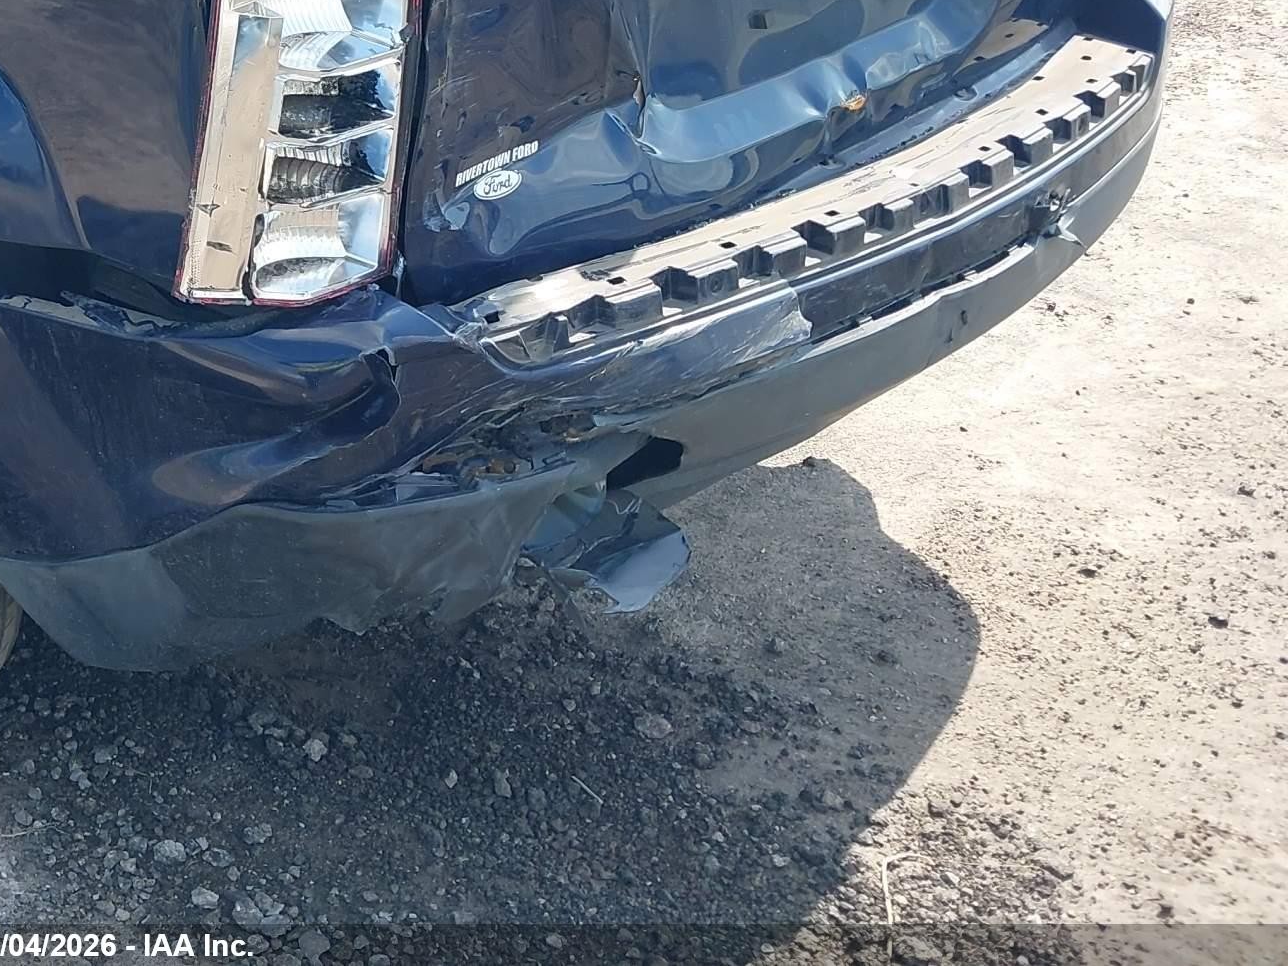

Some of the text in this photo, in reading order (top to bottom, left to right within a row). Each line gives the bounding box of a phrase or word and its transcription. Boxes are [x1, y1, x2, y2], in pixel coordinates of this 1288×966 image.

[455, 140, 539, 188] RIVERTOWN FORD
[483, 174, 512, 195] Ford
